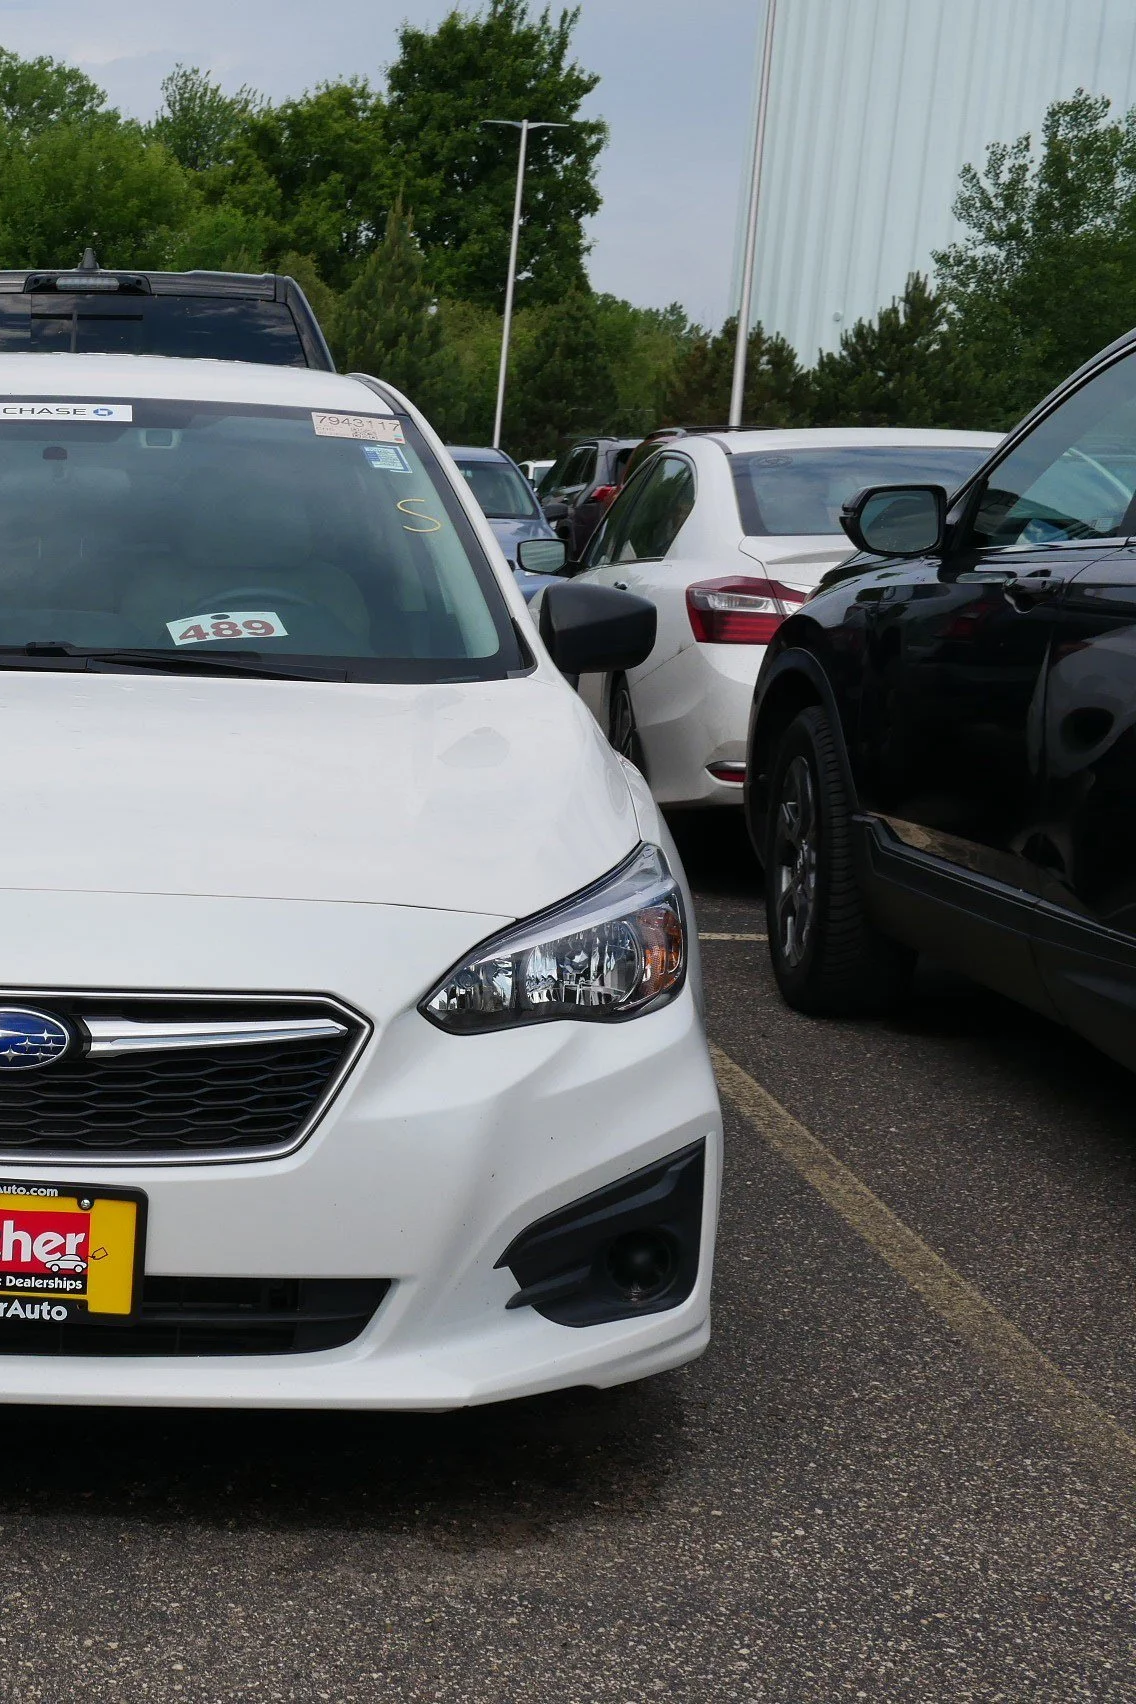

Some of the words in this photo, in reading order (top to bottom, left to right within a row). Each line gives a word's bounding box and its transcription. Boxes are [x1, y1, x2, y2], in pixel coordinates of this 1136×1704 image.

[2, 407, 87, 416] CHASE
[316, 415, 400, 431] 7943117
[396, 498, 441, 532] S
[178, 619, 275, 640] 489
[6, 1275, 83, 1291] Dealerships
